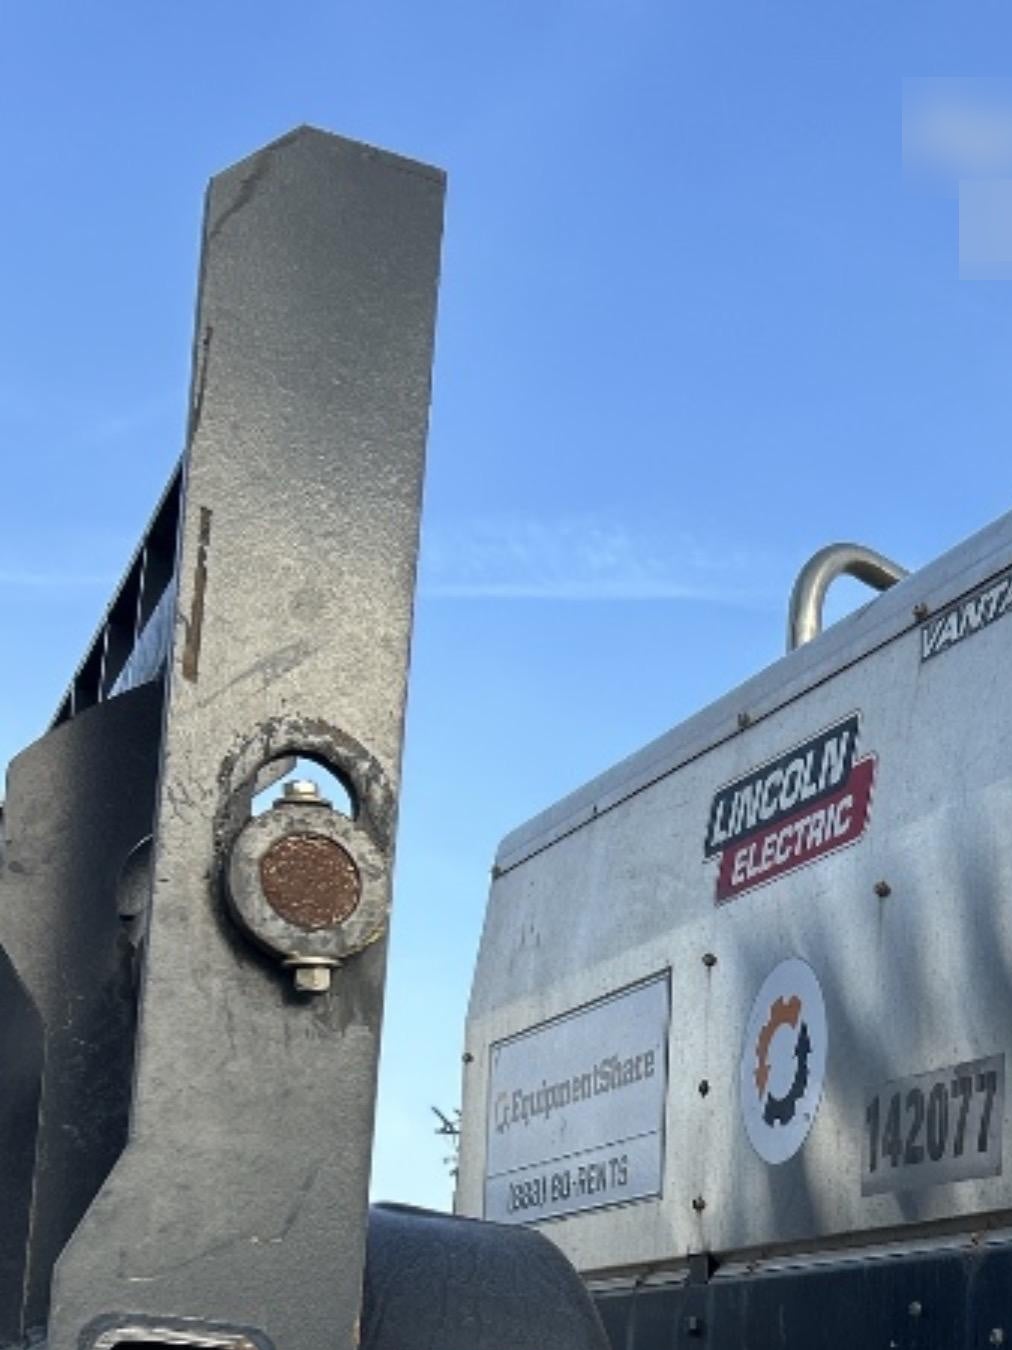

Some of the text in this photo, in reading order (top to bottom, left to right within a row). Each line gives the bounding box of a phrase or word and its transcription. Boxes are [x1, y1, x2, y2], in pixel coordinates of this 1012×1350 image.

[710, 731, 850, 847] LINCOLN
[730, 794, 854, 887] ELECTRIC
[511, 1049, 656, 1128] EquipmentShare
[866, 1070, 997, 1174] 142077
